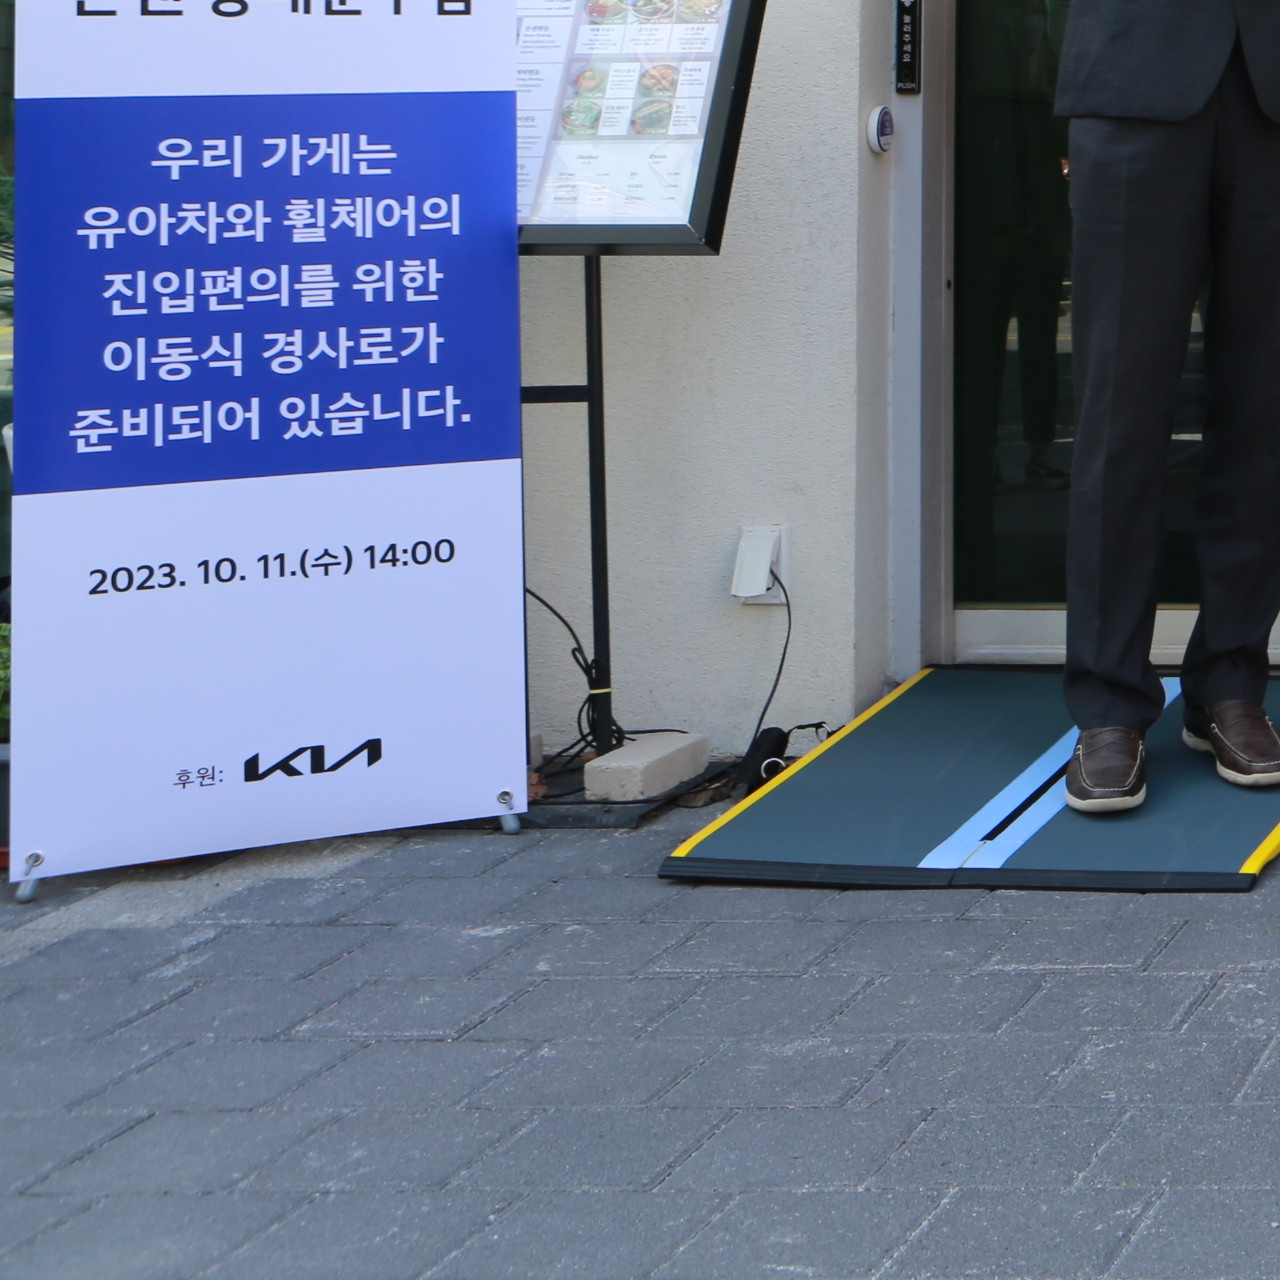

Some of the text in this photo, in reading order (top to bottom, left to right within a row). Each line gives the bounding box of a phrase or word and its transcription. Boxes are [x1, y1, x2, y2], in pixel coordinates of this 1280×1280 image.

[151, 132, 398, 180] 우리 가게는
[76, 193, 462, 250] 유아차와 휠체어의
[102, 257, 445, 317] 진입편의를 위한
[102, 323, 446, 382] 이동식 경사로가
[68, 386, 472, 455] 준비되어 있습니다.
[88, 538, 456, 596] 2023. 10. 11.(수) 14:00
[172, 737, 382, 790] 후원: KIA
